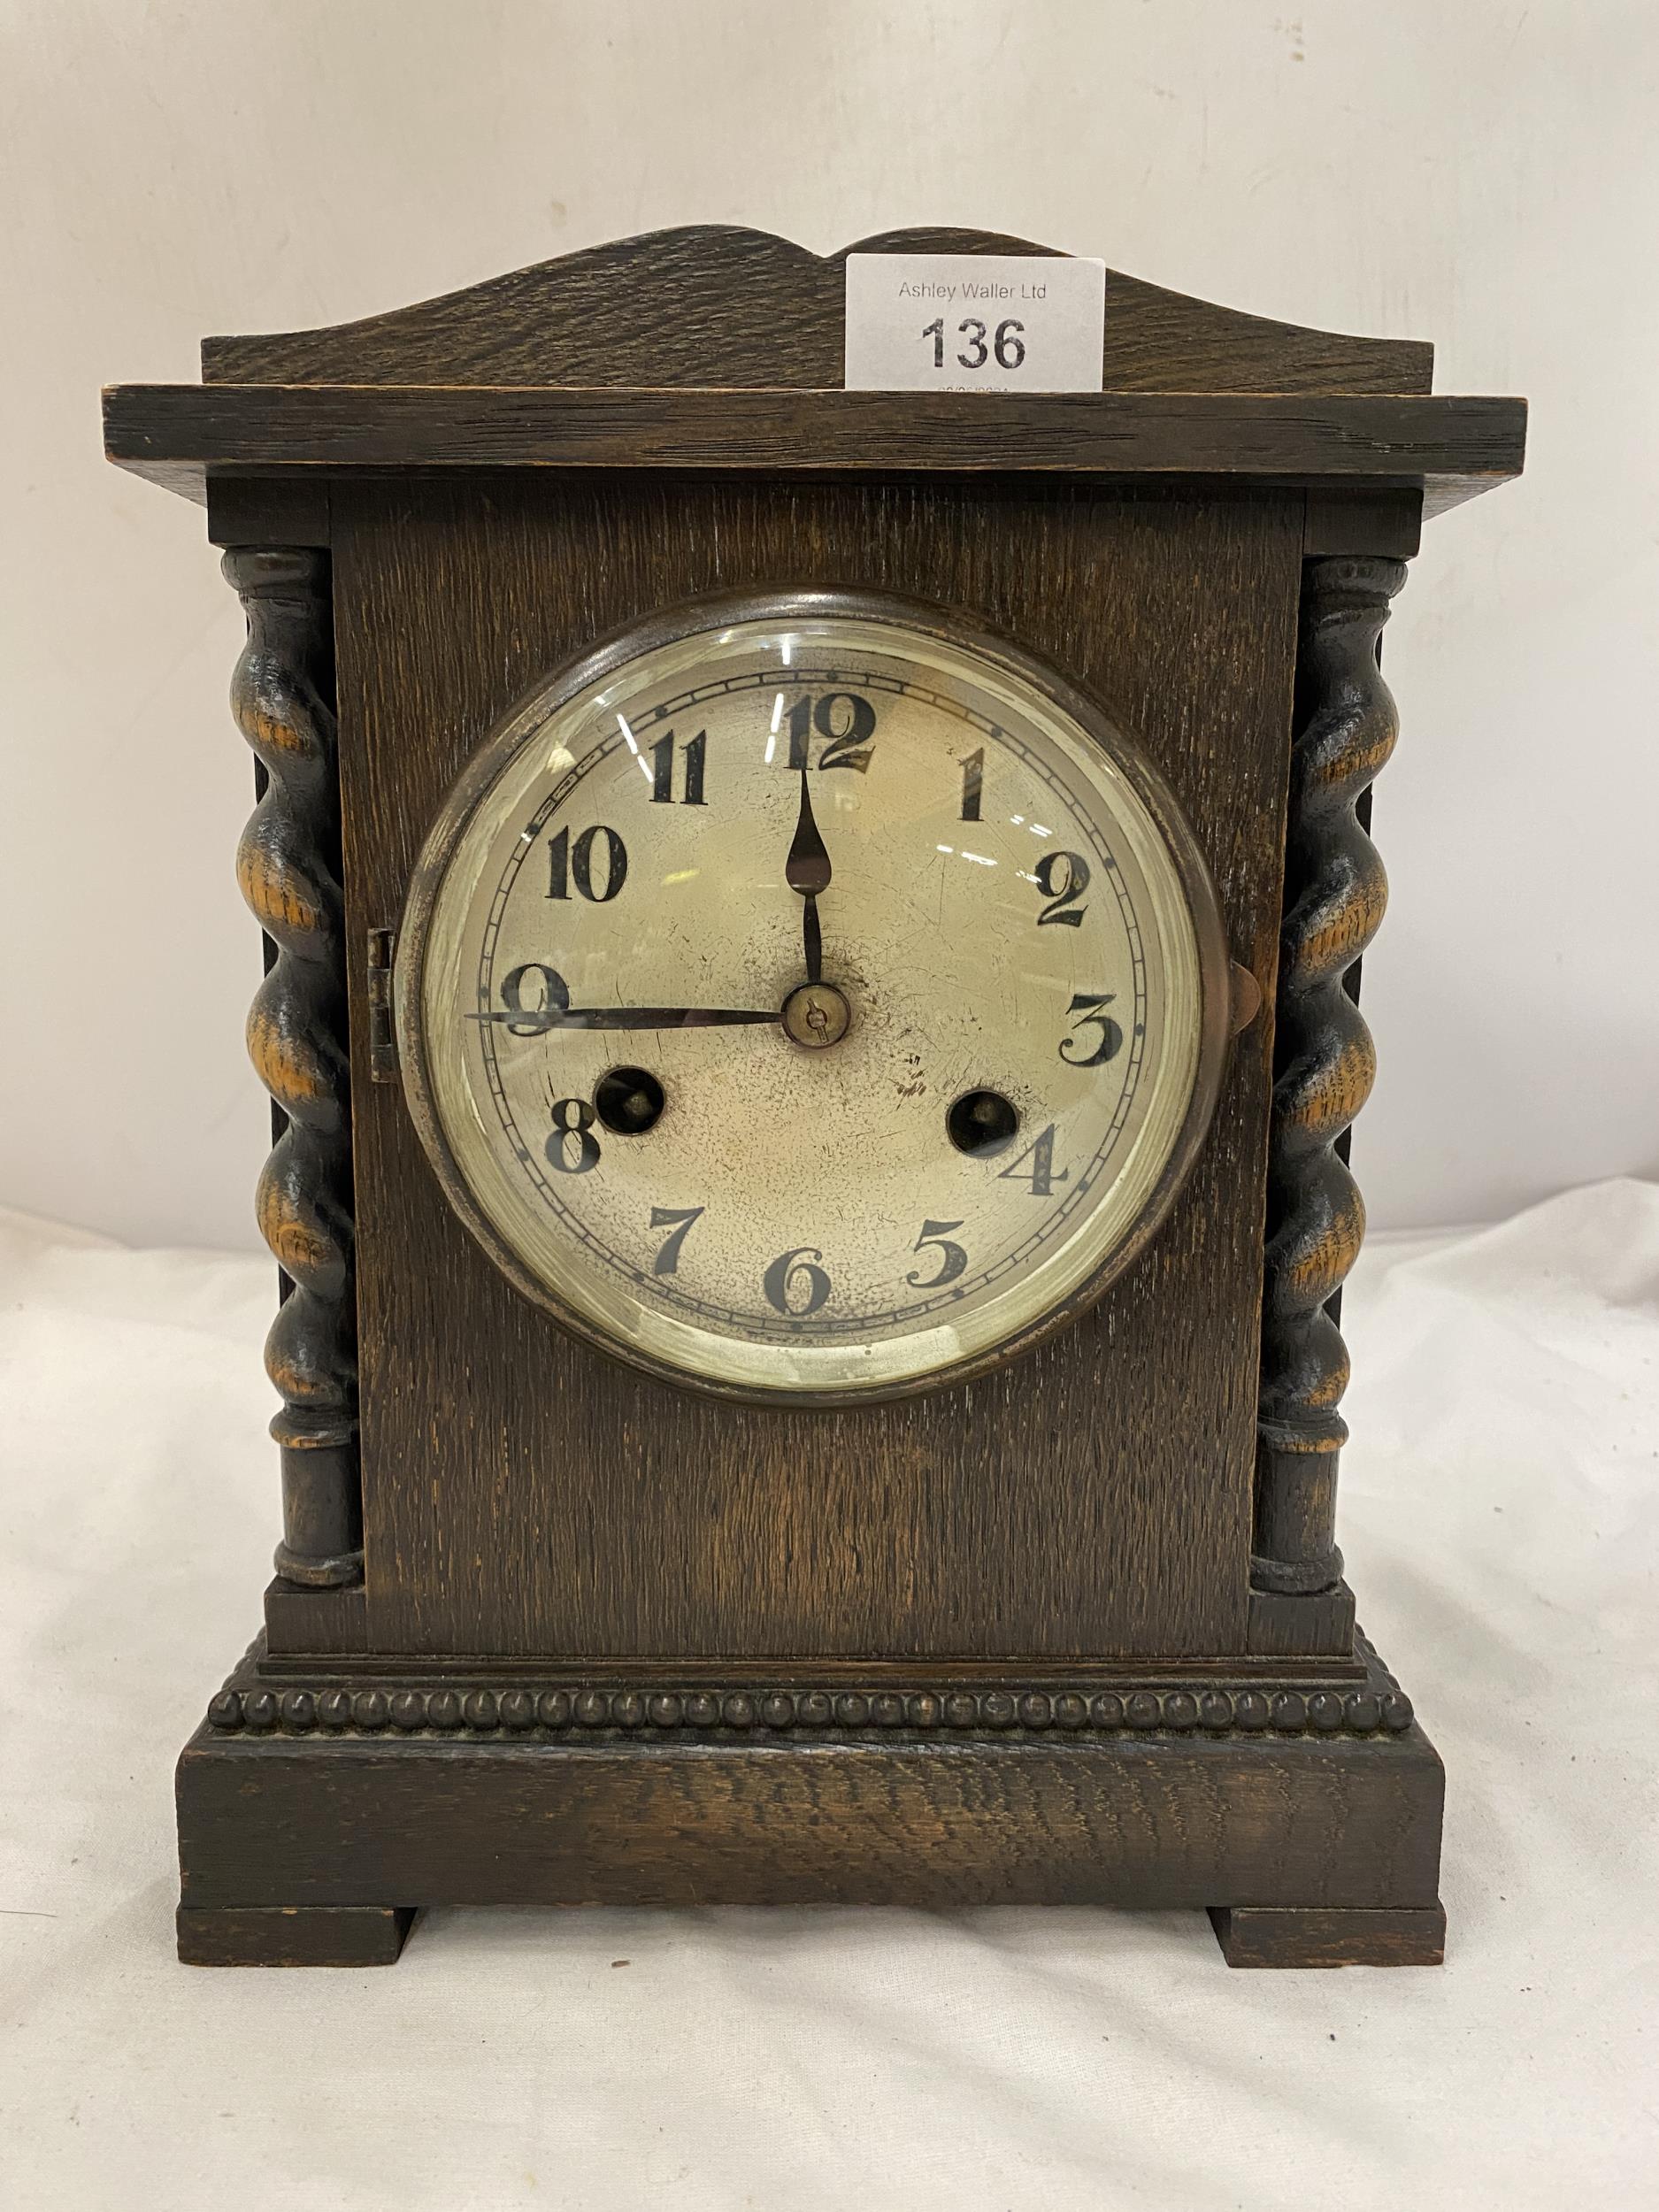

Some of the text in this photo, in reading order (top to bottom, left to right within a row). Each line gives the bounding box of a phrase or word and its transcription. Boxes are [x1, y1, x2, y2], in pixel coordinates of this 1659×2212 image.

[899, 281, 1046, 302] Ashley Waller Ltd
[922, 318, 1025, 369] 136
[648, 728, 709, 806] 11
[783, 692, 877, 774] 12
[958, 748, 986, 821] 1
[543, 825, 628, 902] 10
[1035, 851, 1090, 927] 2
[500, 964, 570, 1037] 9
[1058, 993, 1124, 1066] 3
[544, 1098, 601, 1173] 8
[998, 1123, 1070, 1195] 4
[649, 1205, 705, 1274] 7
[906, 1218, 969, 1288] 5
[763, 1246, 832, 1317] 6
